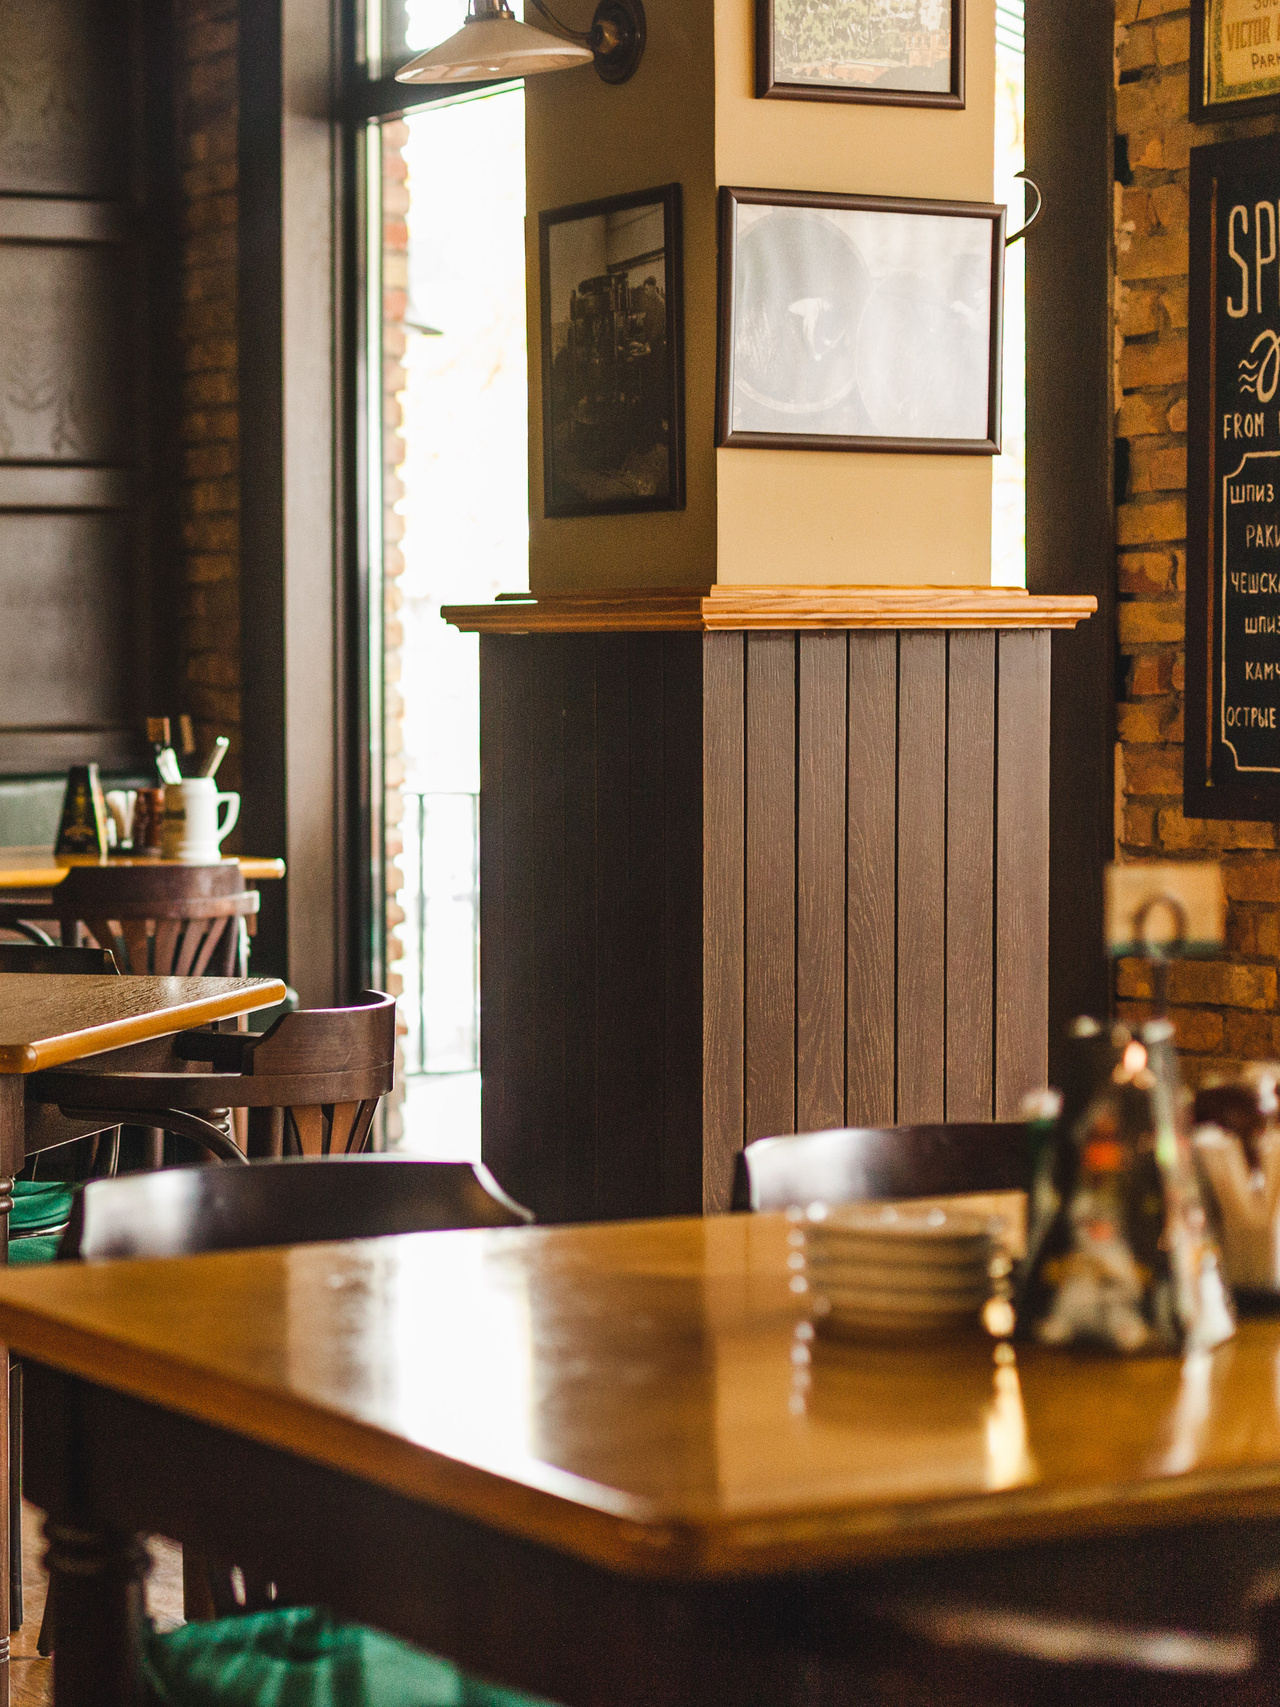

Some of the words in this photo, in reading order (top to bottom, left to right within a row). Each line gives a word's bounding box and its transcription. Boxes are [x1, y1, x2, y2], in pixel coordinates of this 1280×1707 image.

[1227, 200, 1280, 318] SP
[1223, 412, 1264, 439] FROM
[1230, 483, 1274, 504] ШПИЗ
[1231, 572, 1280, 594] ЧЕШСК
[1226, 706, 1276, 729] ОСТРЫЕ
